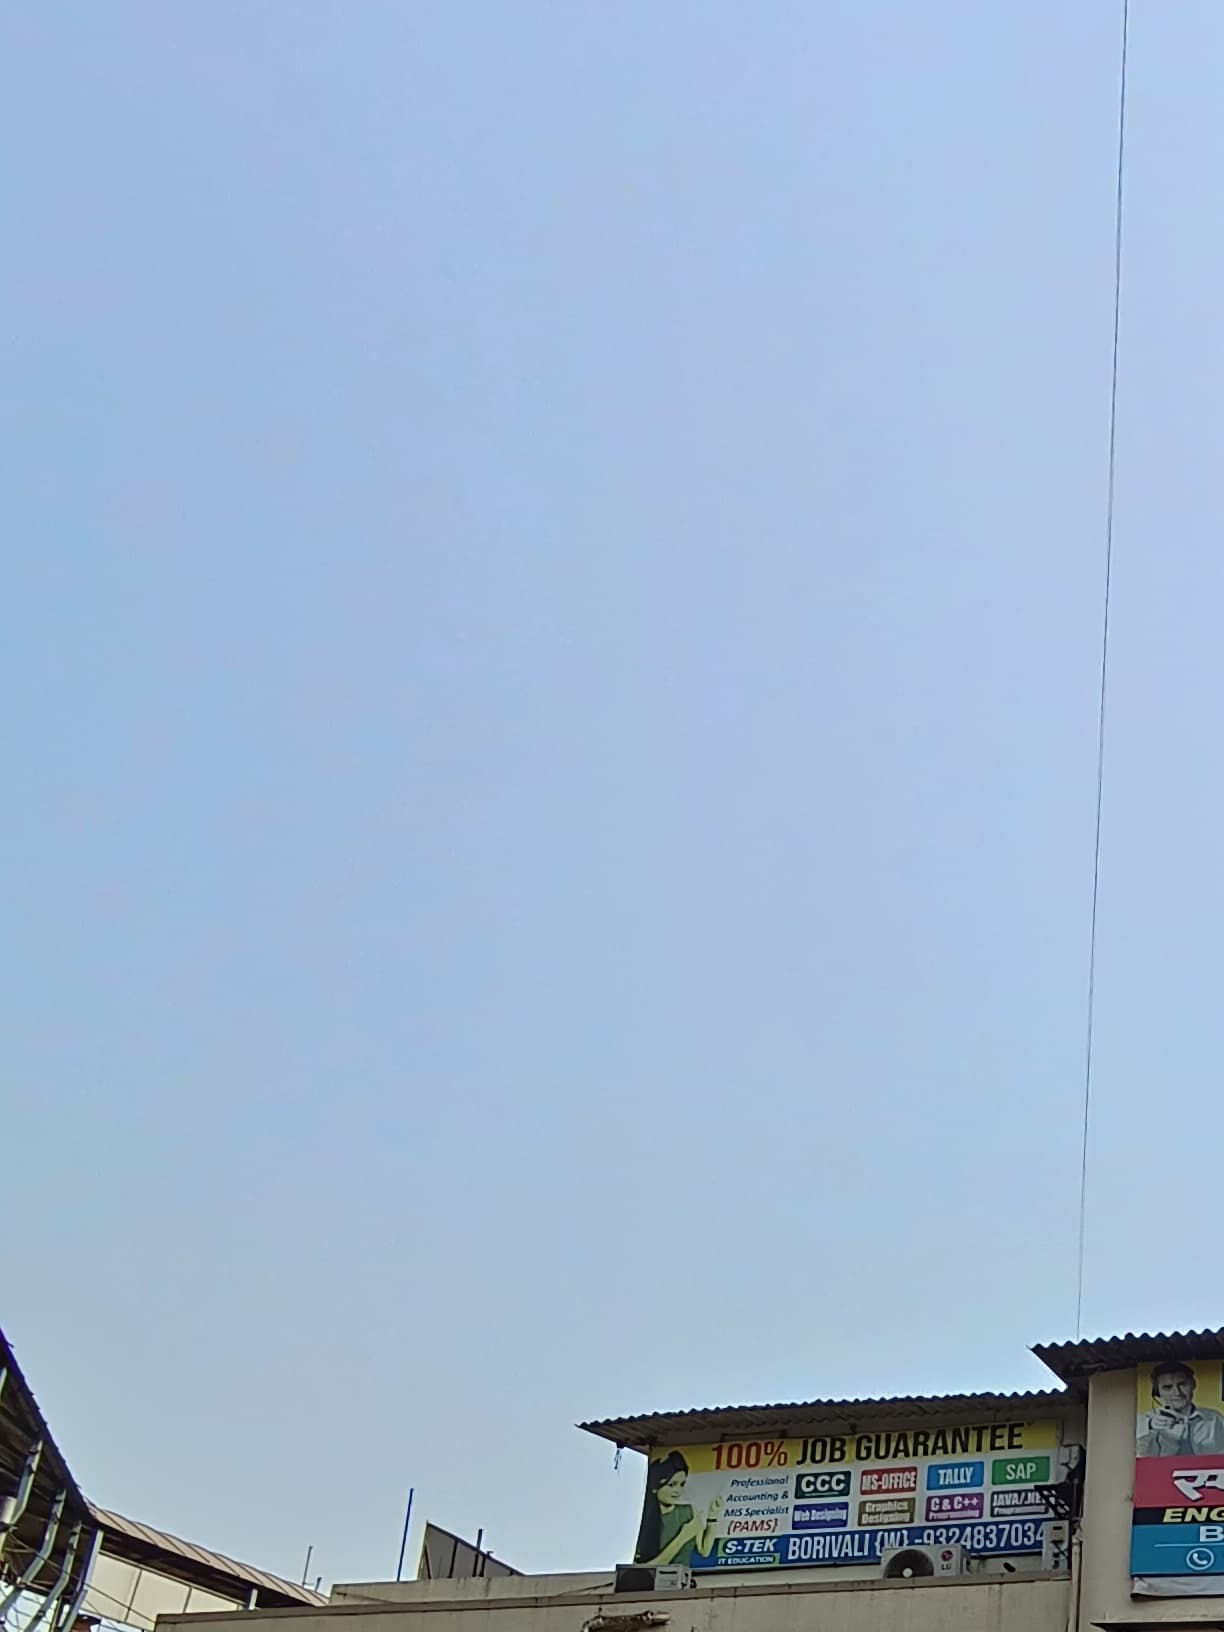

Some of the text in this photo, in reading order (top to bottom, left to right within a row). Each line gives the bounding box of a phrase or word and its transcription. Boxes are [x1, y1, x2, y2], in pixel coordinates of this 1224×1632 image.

[711, 1440, 788, 1470] 100%
[796, 1436, 847, 1466] JOB
[938, 1467, 974, 1485] TALLY
[1006, 1463, 1037, 1481] SAP
[731, 1475, 789, 1488] Professional
[801, 1474, 846, 1492] CCC
[861, 1471, 916, 1491] MS-OFFICE
[726, 1491, 789, 1503] Accounting &
[930, 1497, 940, 1511] C
[954, 1496, 979, 1510] C++
[724, 1505, 789, 1518] MIS Specialist
[725, 1539, 779, 1554] S-TEK
[788, 1530, 869, 1561] BORIVALI
[718, 1556, 774, 1565] IT EDUCATION
